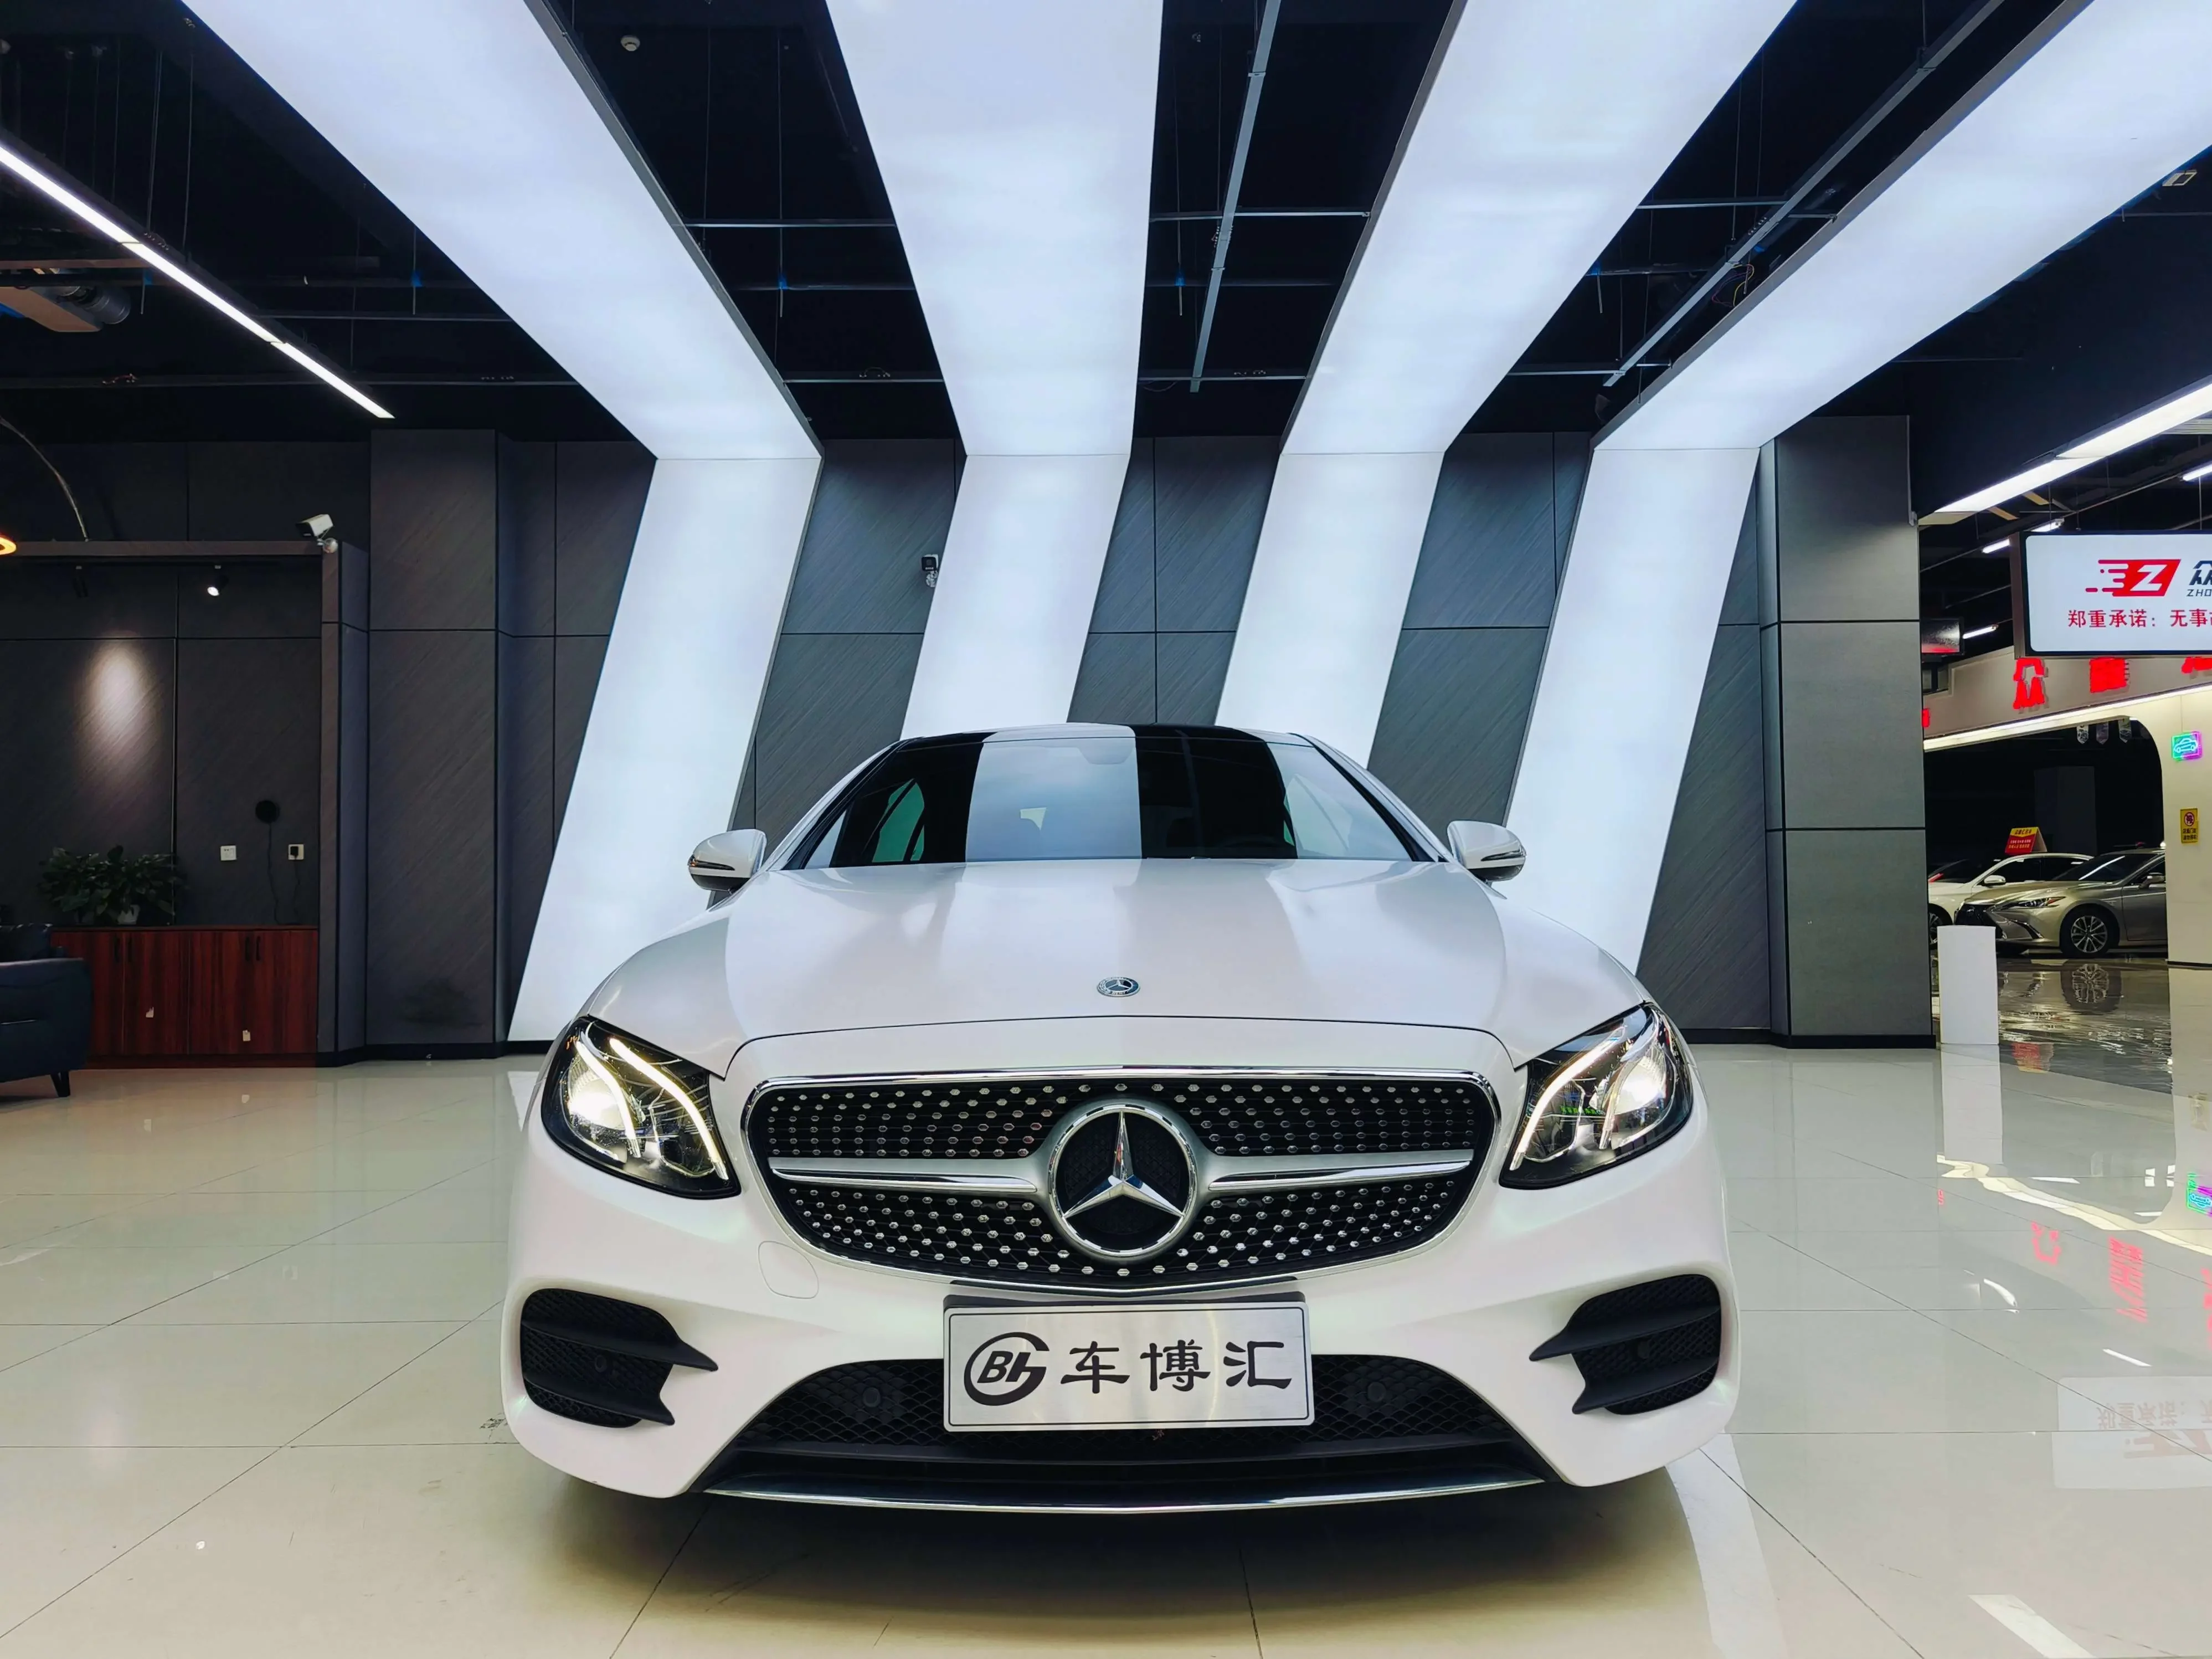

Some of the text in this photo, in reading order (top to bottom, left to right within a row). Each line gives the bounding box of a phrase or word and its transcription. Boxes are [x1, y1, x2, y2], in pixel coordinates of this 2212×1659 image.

[2067, 608, 2212, 628] 郑重承诺：无事
[1060, 1339, 1292, 1394] 车博汇
